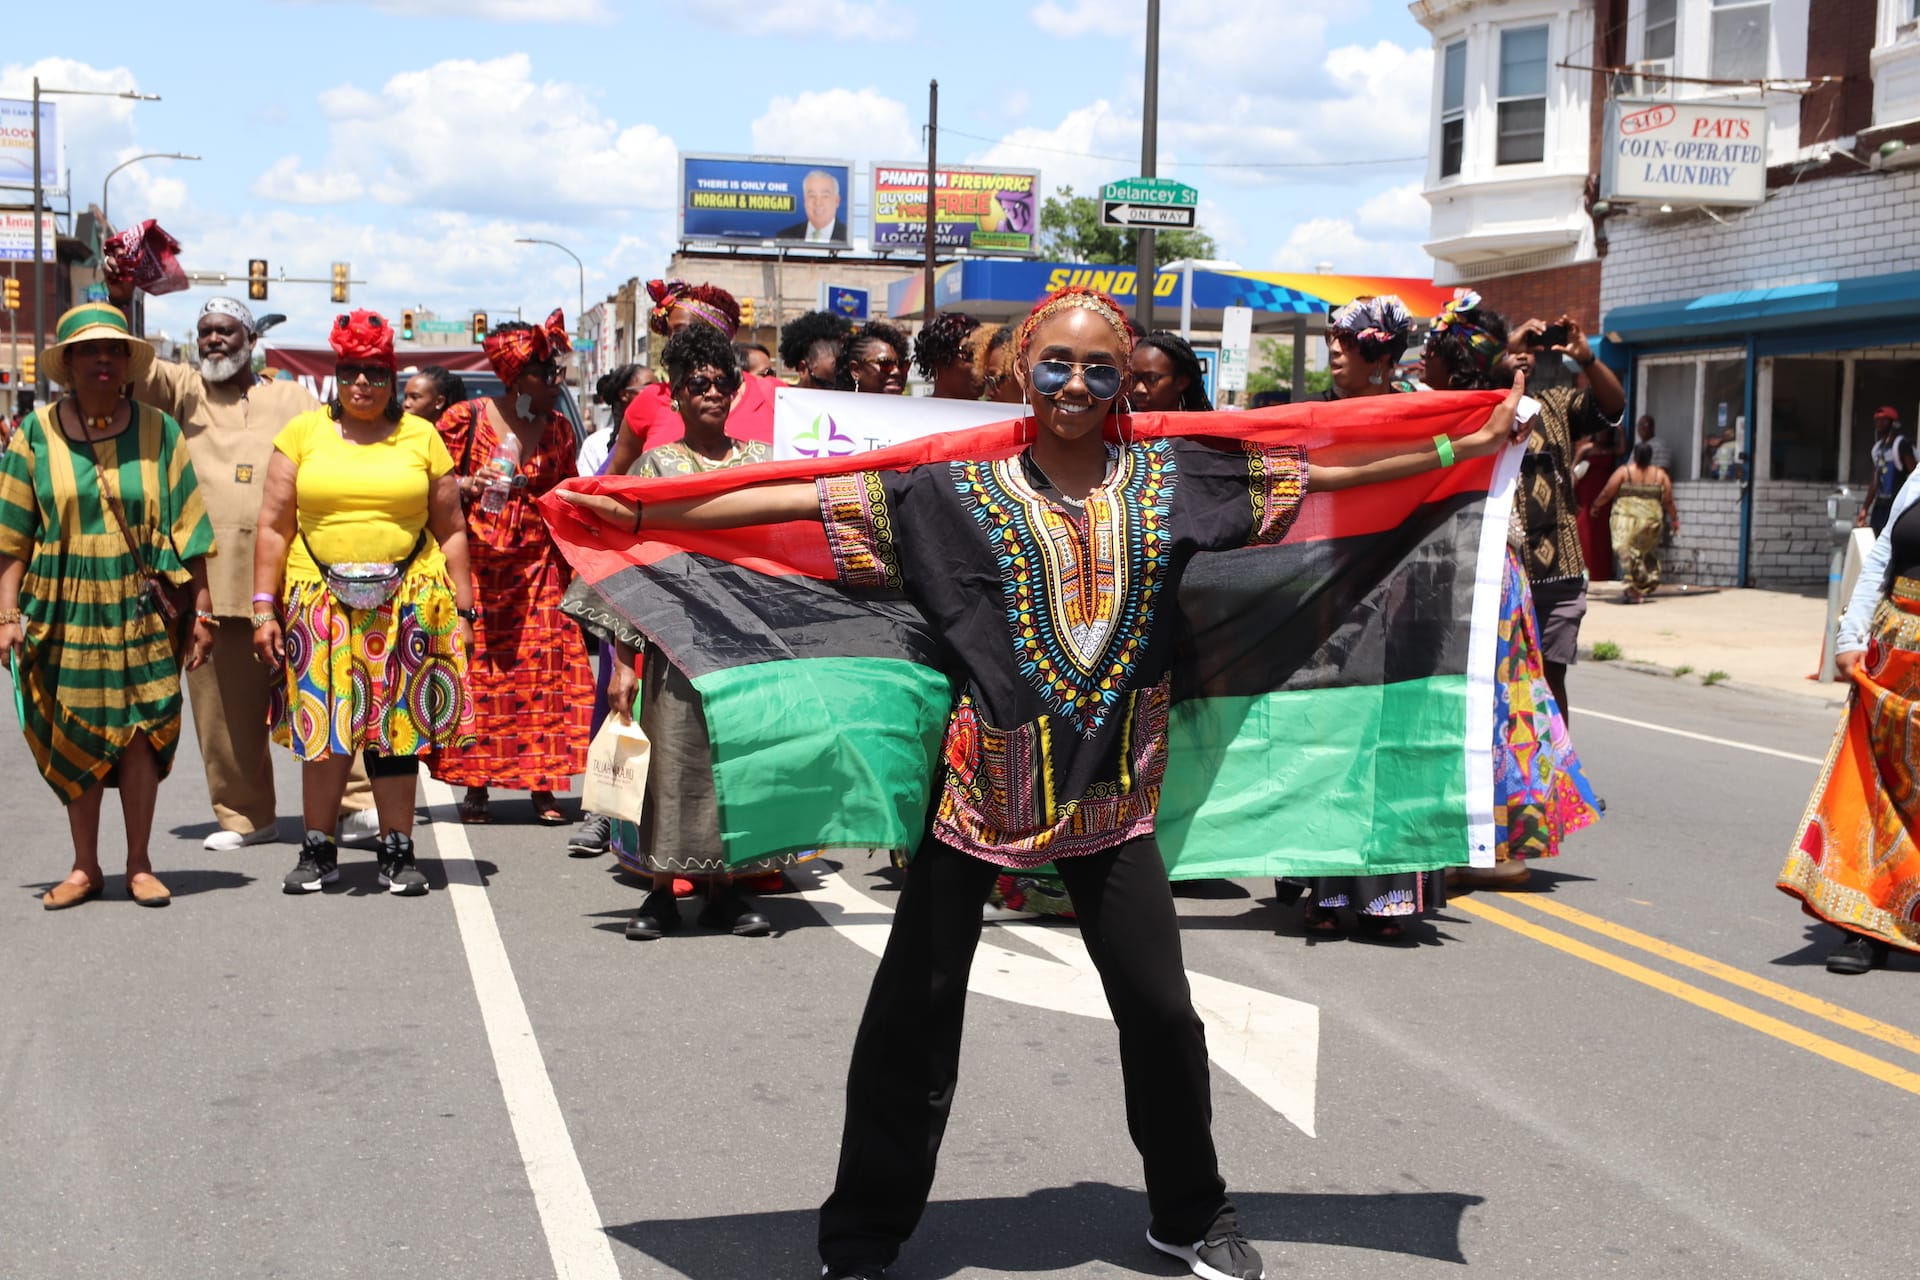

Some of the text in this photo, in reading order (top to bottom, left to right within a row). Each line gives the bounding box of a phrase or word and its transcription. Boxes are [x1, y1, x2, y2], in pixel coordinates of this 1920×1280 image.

[1632, 111, 1663, 129] 319
[1619, 137, 1762, 164] COIN-OPERATED
[950, 174, 1032, 192] FIREWORKS
[1643, 162, 1736, 187] LAUNDRY
[697, 179, 788, 192] THERE IS ONLY ONE
[1106, 184, 1196, 205] Delancey St
[694, 193, 791, 210] MORGAN & MORGAN
[878, 206, 896, 215] GET
[935, 193, 991, 216] FREE
[879, 192, 903, 205] BUY
[1129, 208, 1184, 221] ONE WAY
[897, 223, 953, 234] 2 PHLY
[881, 232, 964, 246] LOCATONS!
[1045, 268, 1178, 297] SUNOO
